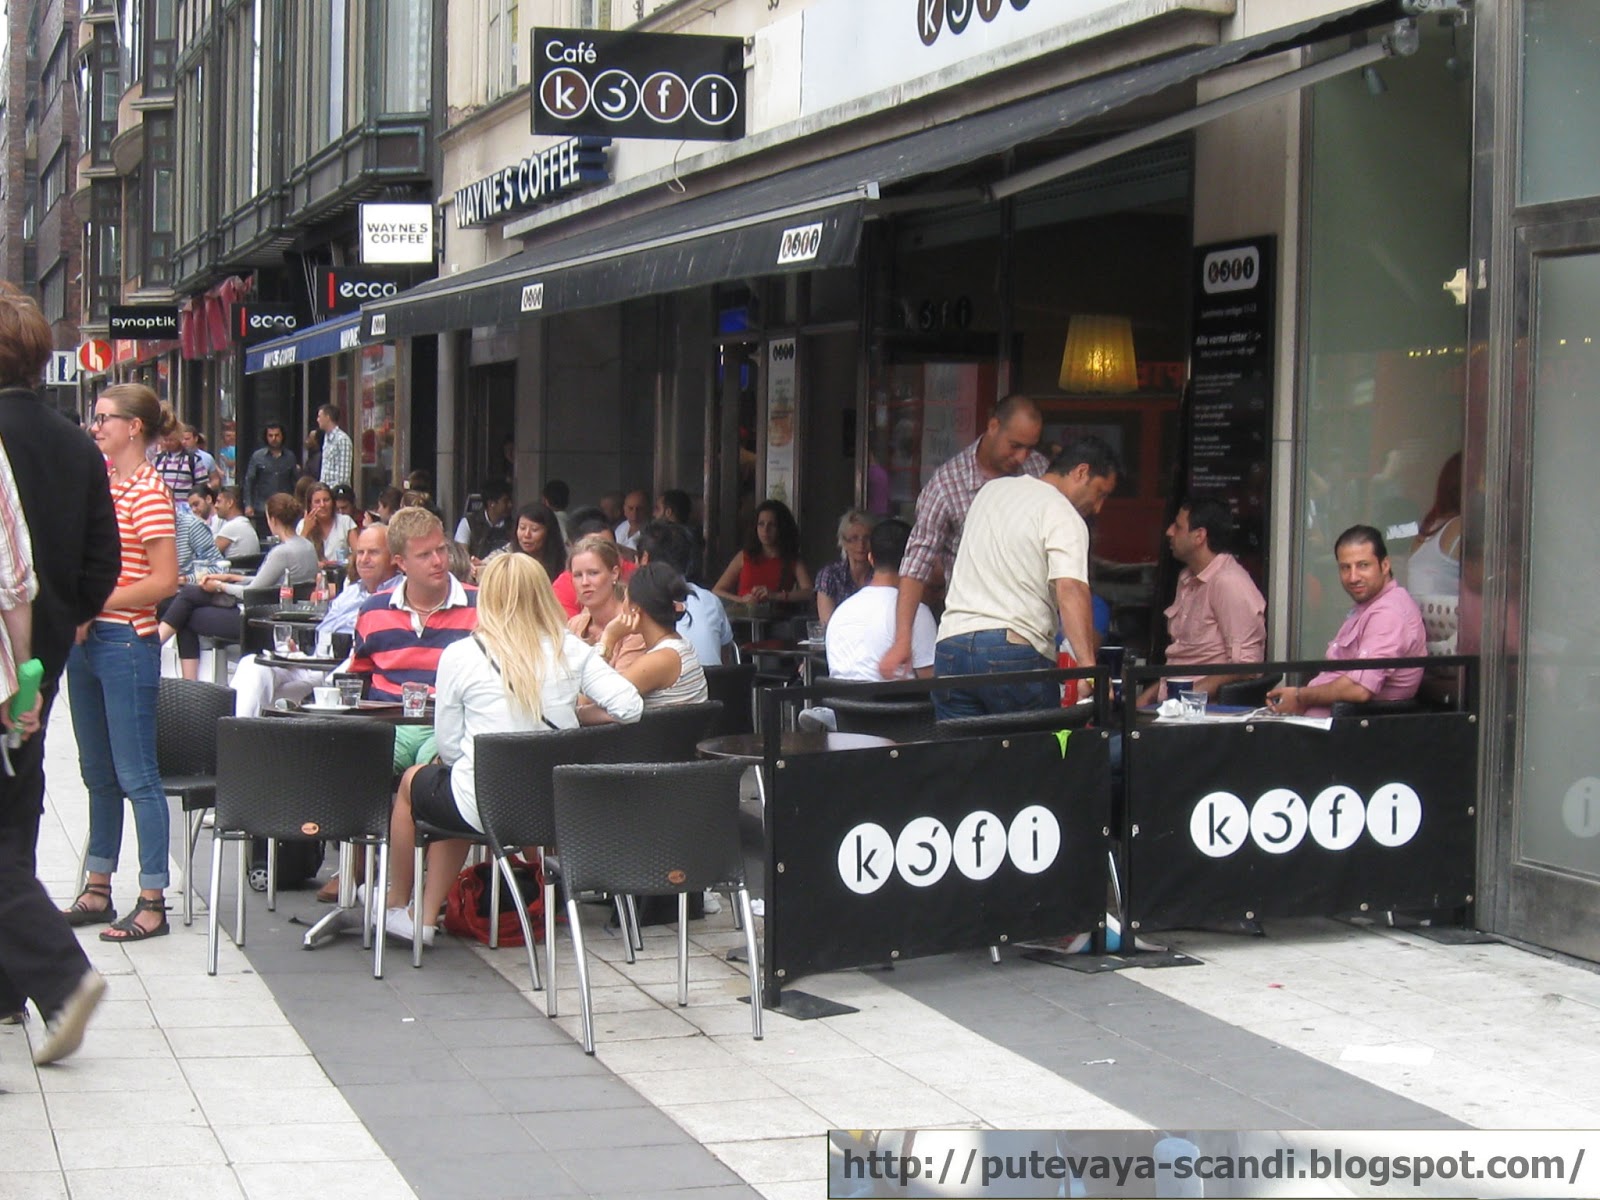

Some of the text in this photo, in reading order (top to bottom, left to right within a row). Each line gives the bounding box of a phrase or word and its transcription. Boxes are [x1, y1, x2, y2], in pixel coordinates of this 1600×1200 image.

[545, 40, 597, 64] Café
[455, 136, 581, 229] WAYNE'S COFFEE
[366, 222, 429, 245] WAYNE'S COFFEE
[339, 281, 398, 299] ecco
[111, 315, 176, 329] synoptik
